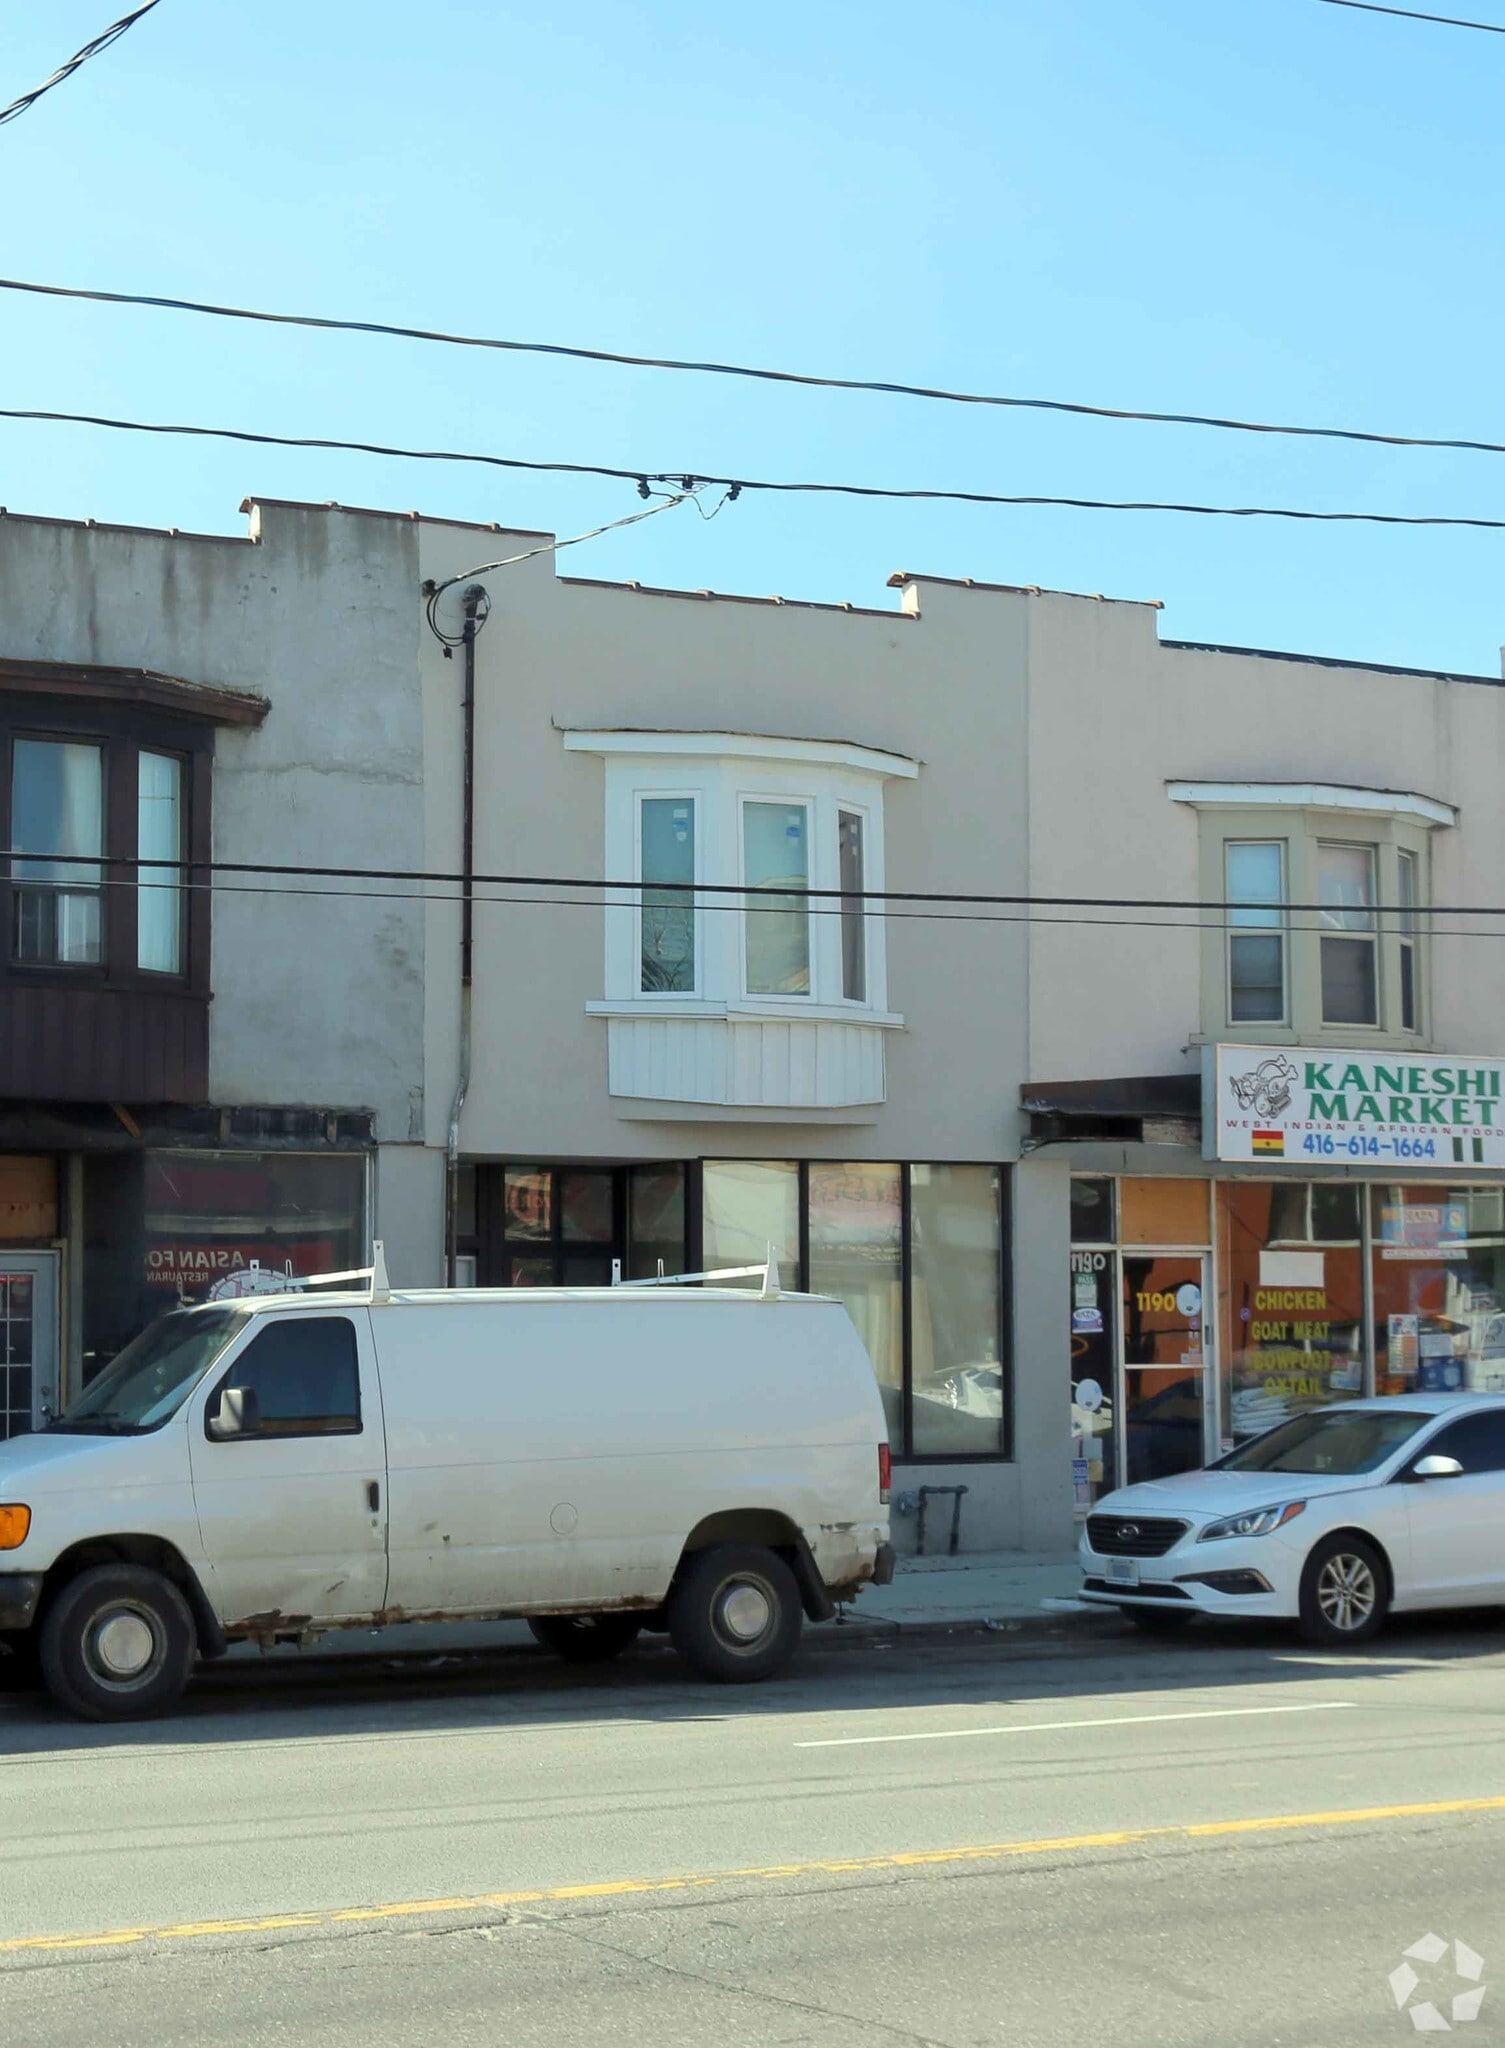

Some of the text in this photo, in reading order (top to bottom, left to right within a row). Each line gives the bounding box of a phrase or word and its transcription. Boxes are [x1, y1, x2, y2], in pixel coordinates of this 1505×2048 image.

[1304, 1062, 1501, 1097] KANESHI
[1308, 1093, 1498, 1125] MARKET
[1226, 1120, 1271, 1128] WEST
[1283, 1121, 1345, 1131] INDIAN
[1378, 1125, 1452, 1134] AFRICAN
[1303, 1134, 1435, 1158] 416-614-1664
[1071, 1252, 1106, 1273] 1190
[1136, 1292, 1176, 1312] 1190
[1255, 1290, 1327, 1310] CHICKEN
[1252, 1321, 1330, 1340] GOAT MEAT
